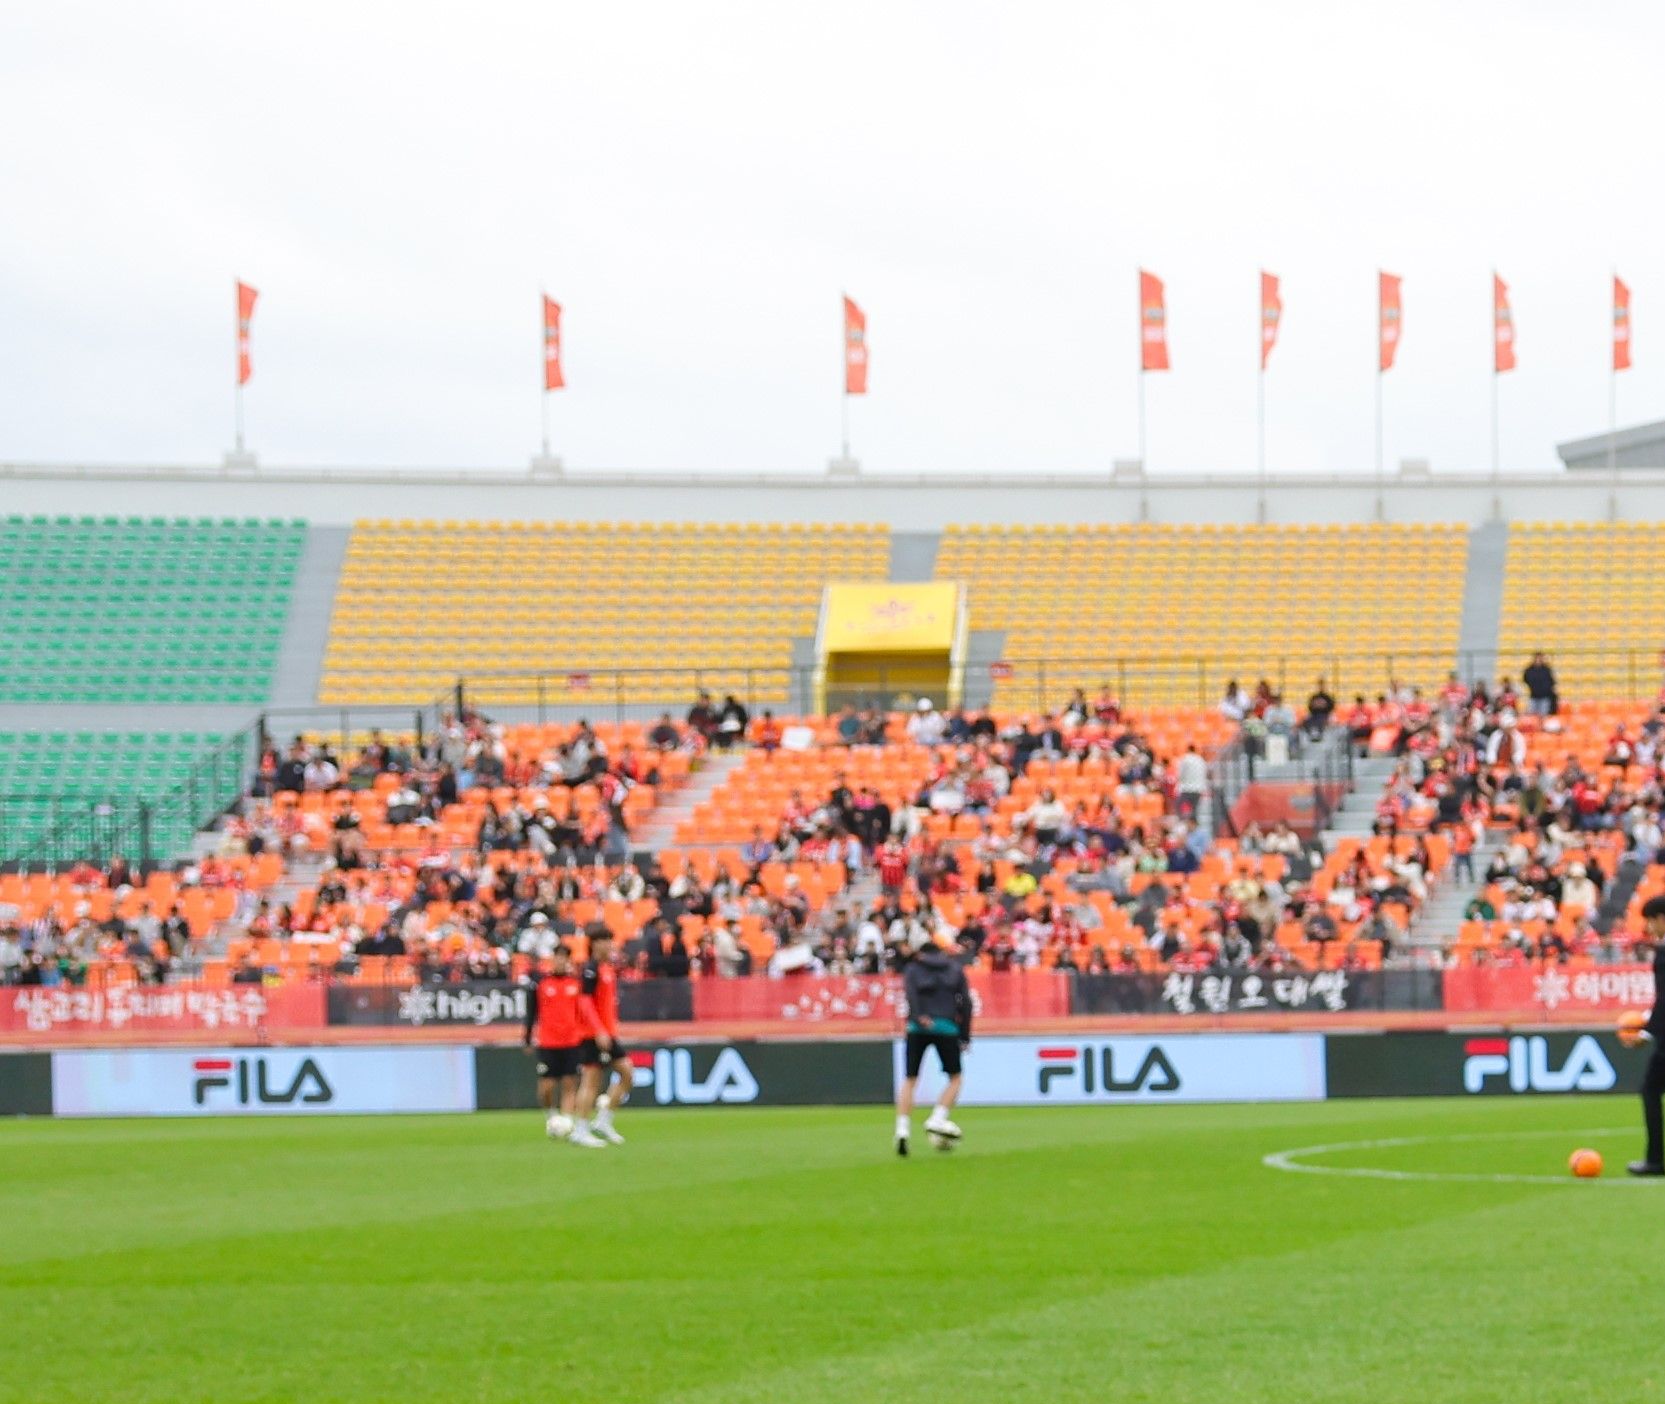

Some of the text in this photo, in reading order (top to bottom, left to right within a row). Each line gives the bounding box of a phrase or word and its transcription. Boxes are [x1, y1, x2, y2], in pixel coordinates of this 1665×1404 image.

[193, 1058, 333, 1105] FILA
[1038, 1046, 1181, 1093] FILA
[1464, 1035, 1616, 1092] FILA
